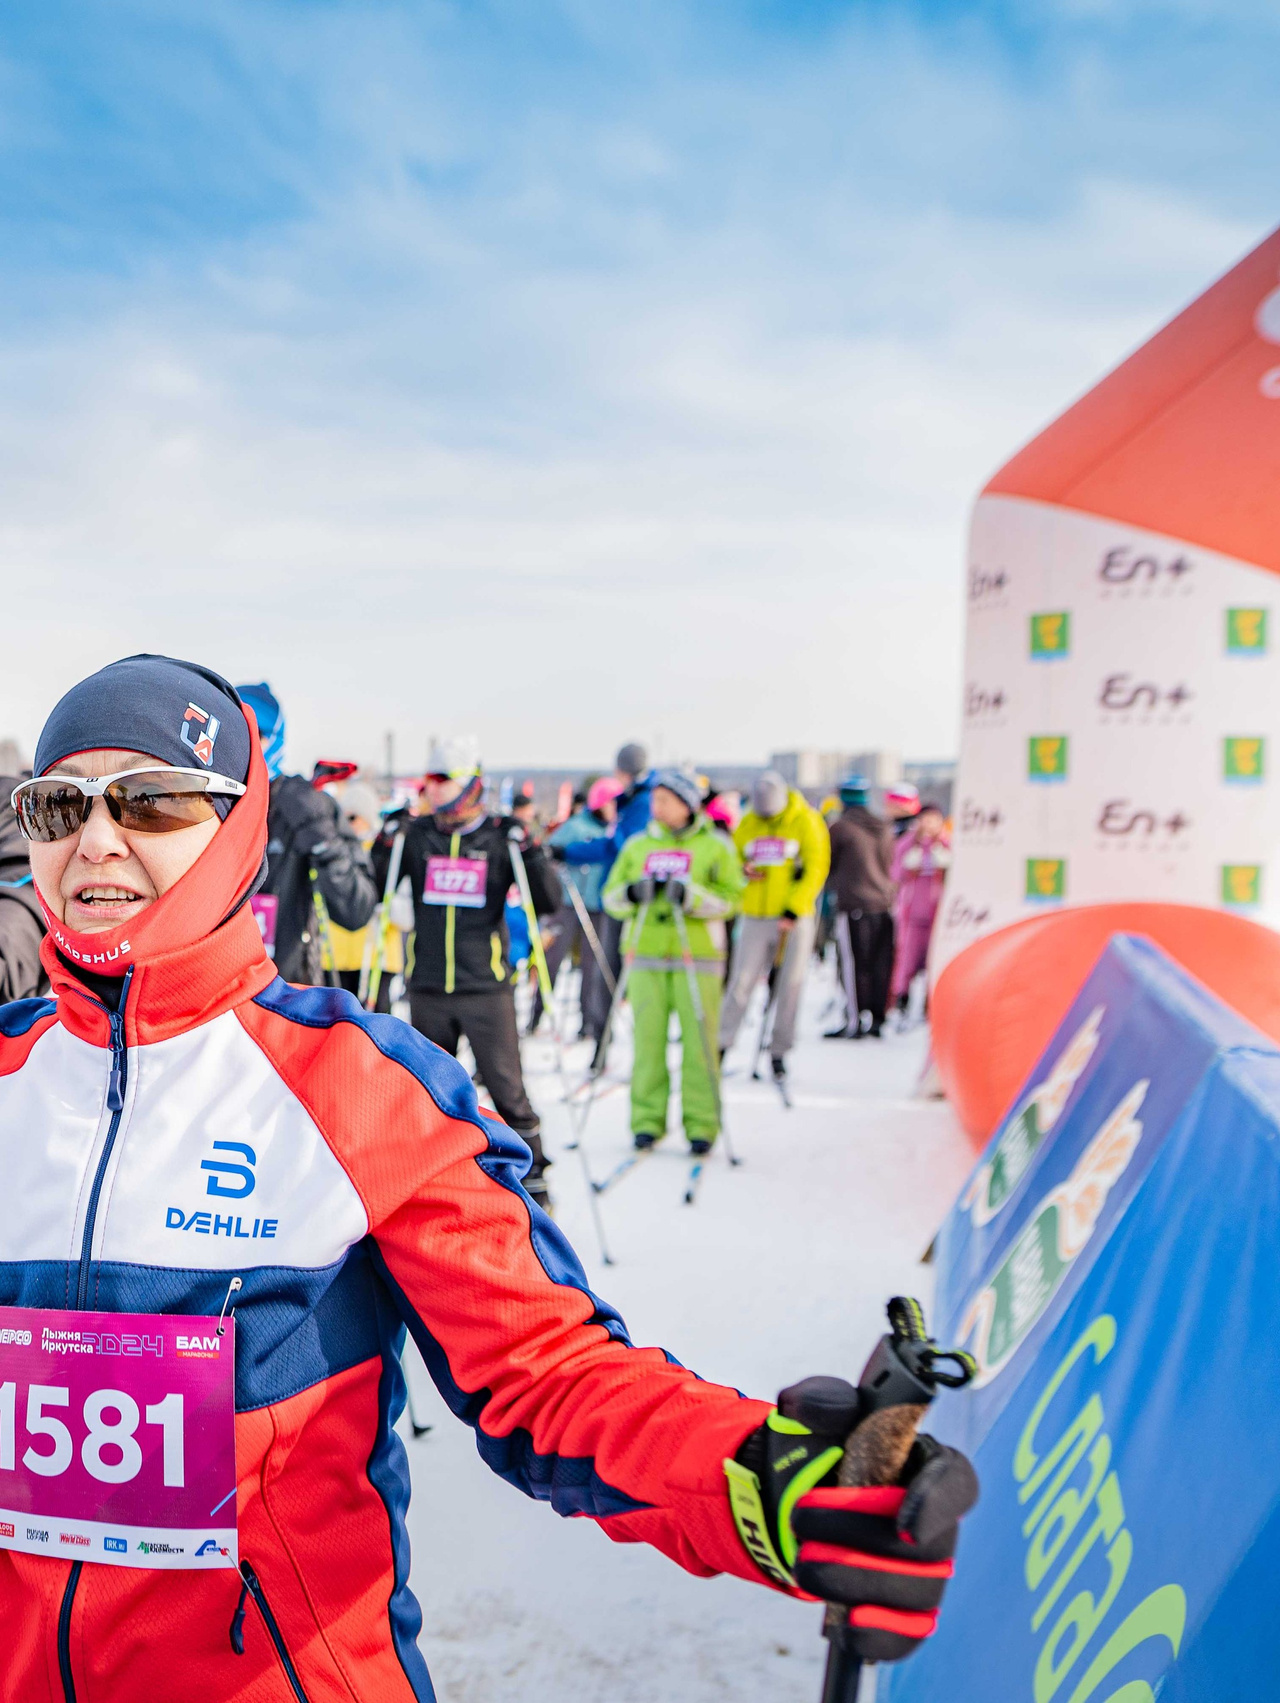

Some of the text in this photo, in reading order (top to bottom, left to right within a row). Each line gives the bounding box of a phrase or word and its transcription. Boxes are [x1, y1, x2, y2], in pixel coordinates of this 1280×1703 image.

[434, 868, 479, 893] 1272
[55, 931, 132, 964] MADSHUS
[41, 1327, 81, 1341] Лыжня
[176, 1336, 220, 1350] БАМ
[41, 1339, 94, 1355] Иркутска
[82, 1332, 164, 1357] 2024
